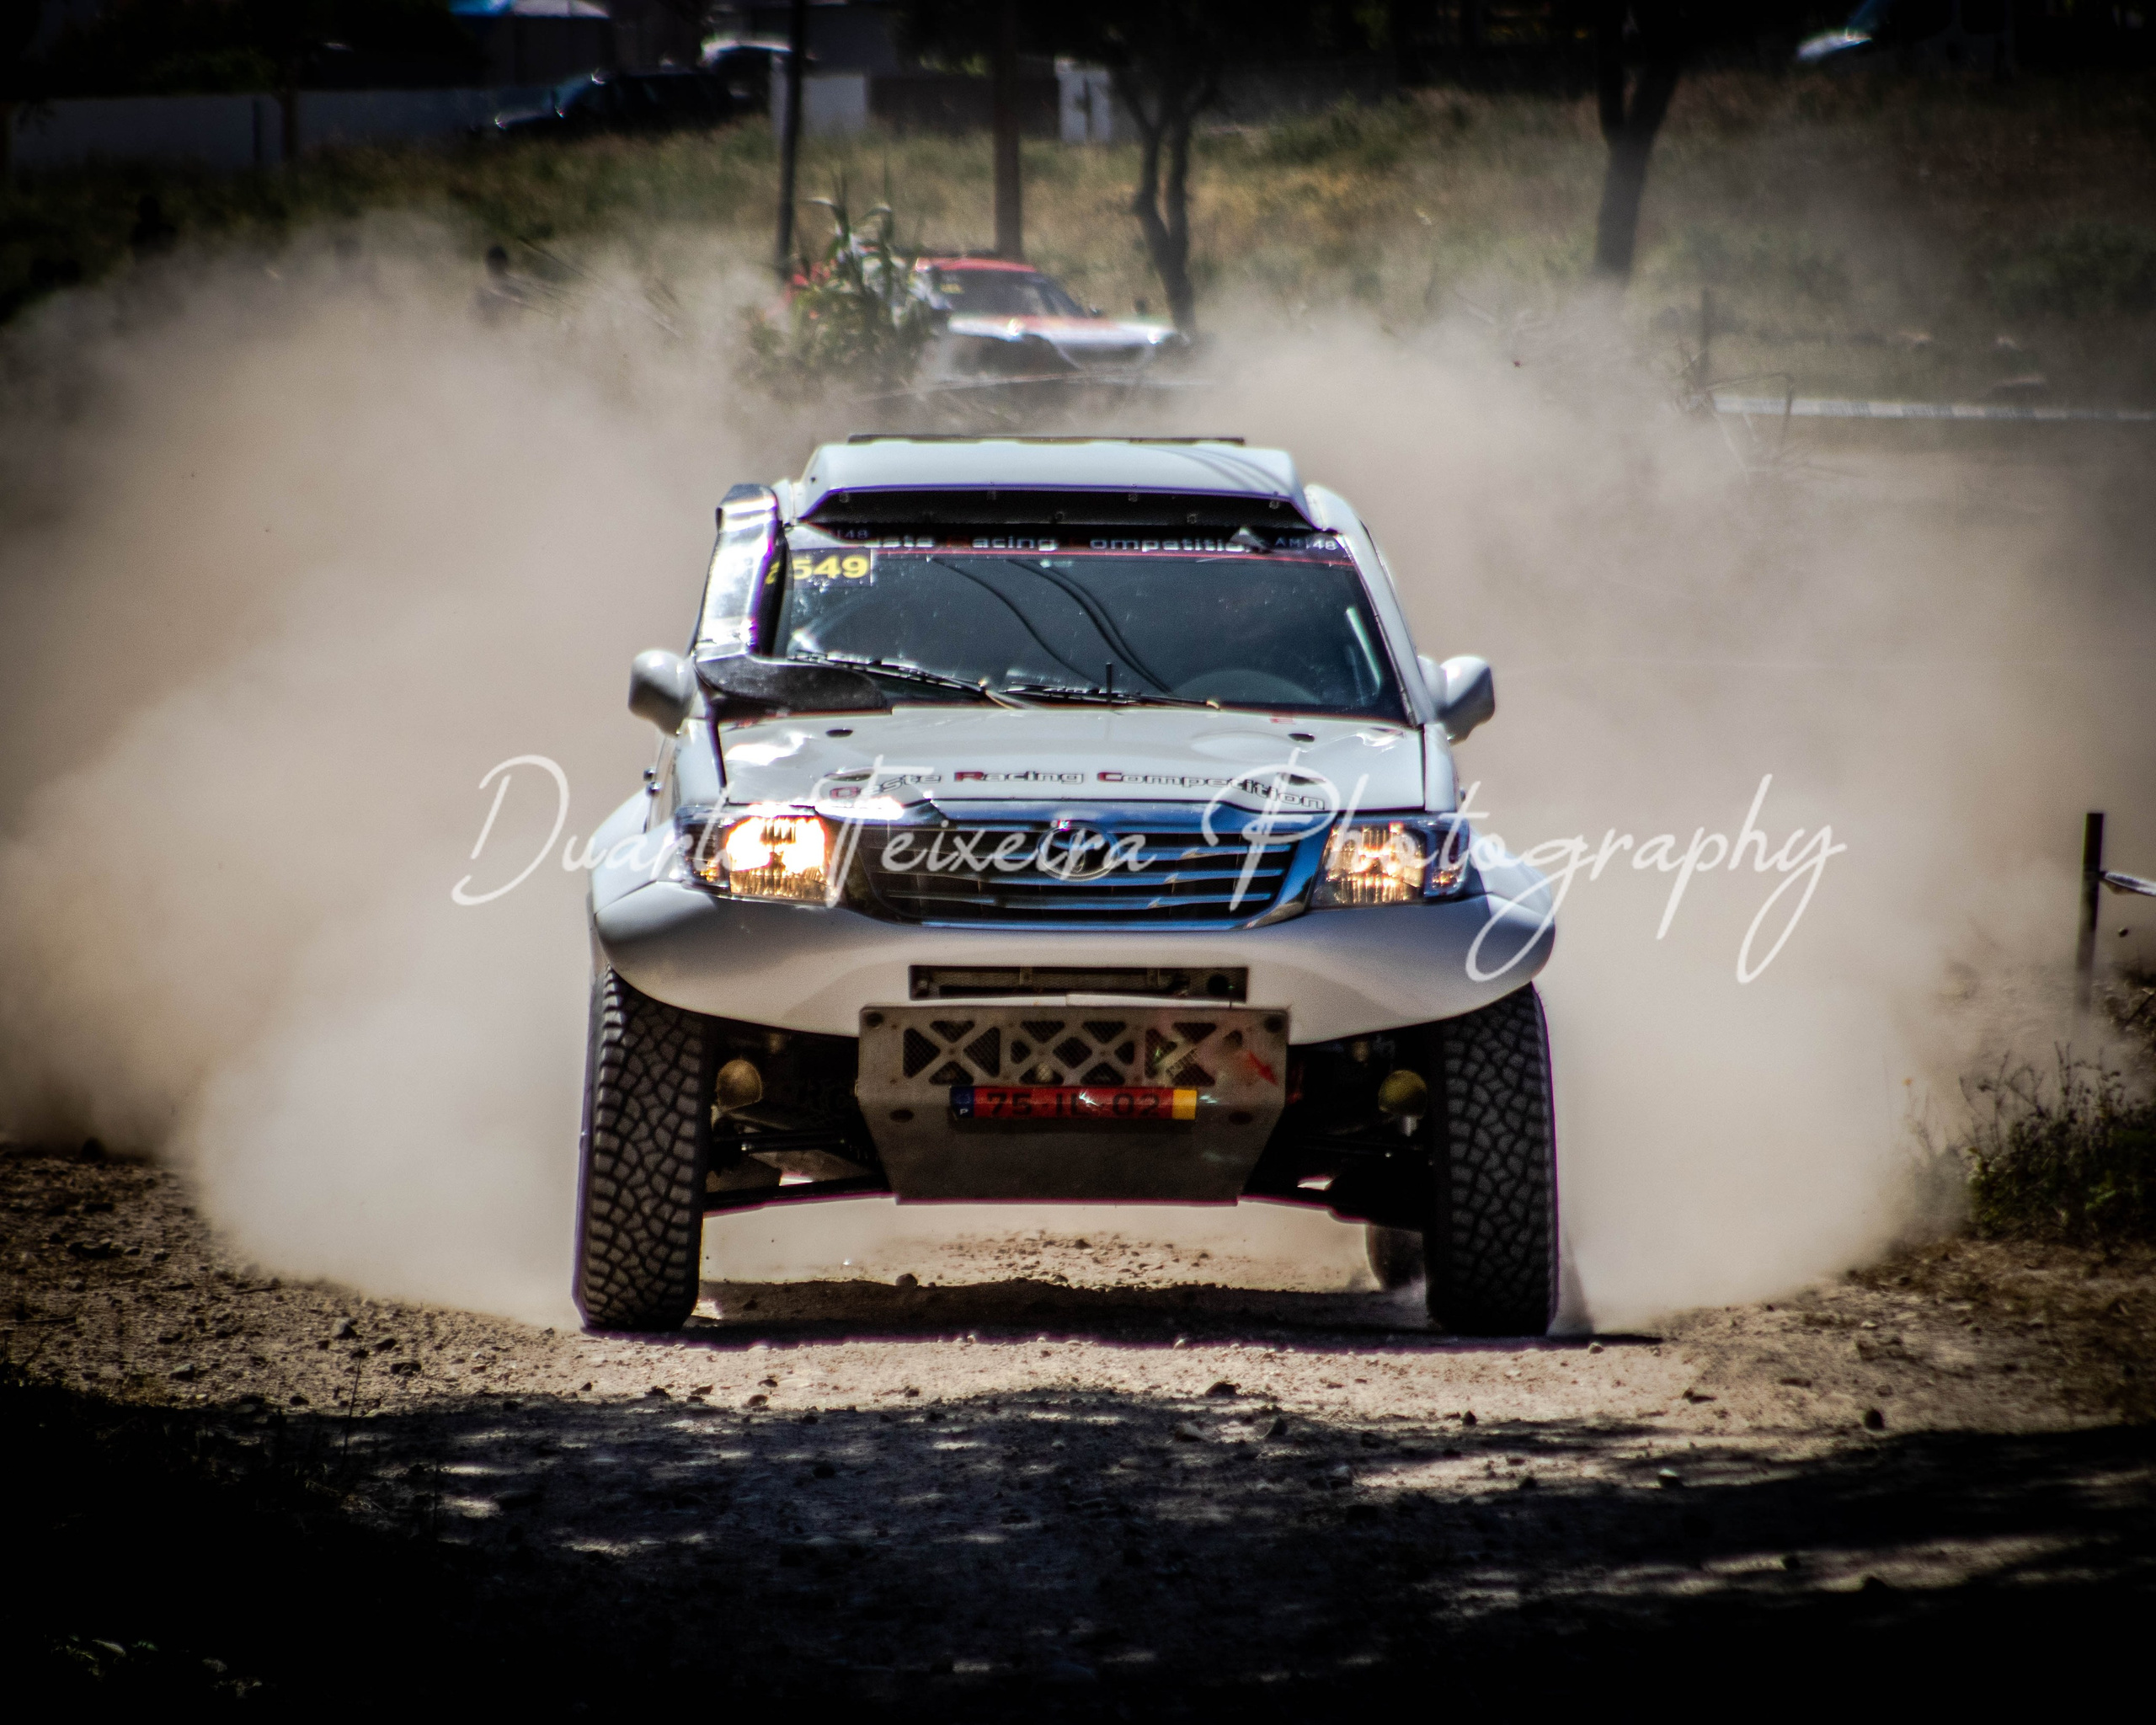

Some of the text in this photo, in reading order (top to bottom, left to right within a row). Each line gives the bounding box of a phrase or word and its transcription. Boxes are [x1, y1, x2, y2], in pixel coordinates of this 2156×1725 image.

[792, 555, 869, 580] 549
[953, 770, 1085, 785] Racing
[1097, 770, 1326, 811] Competition
